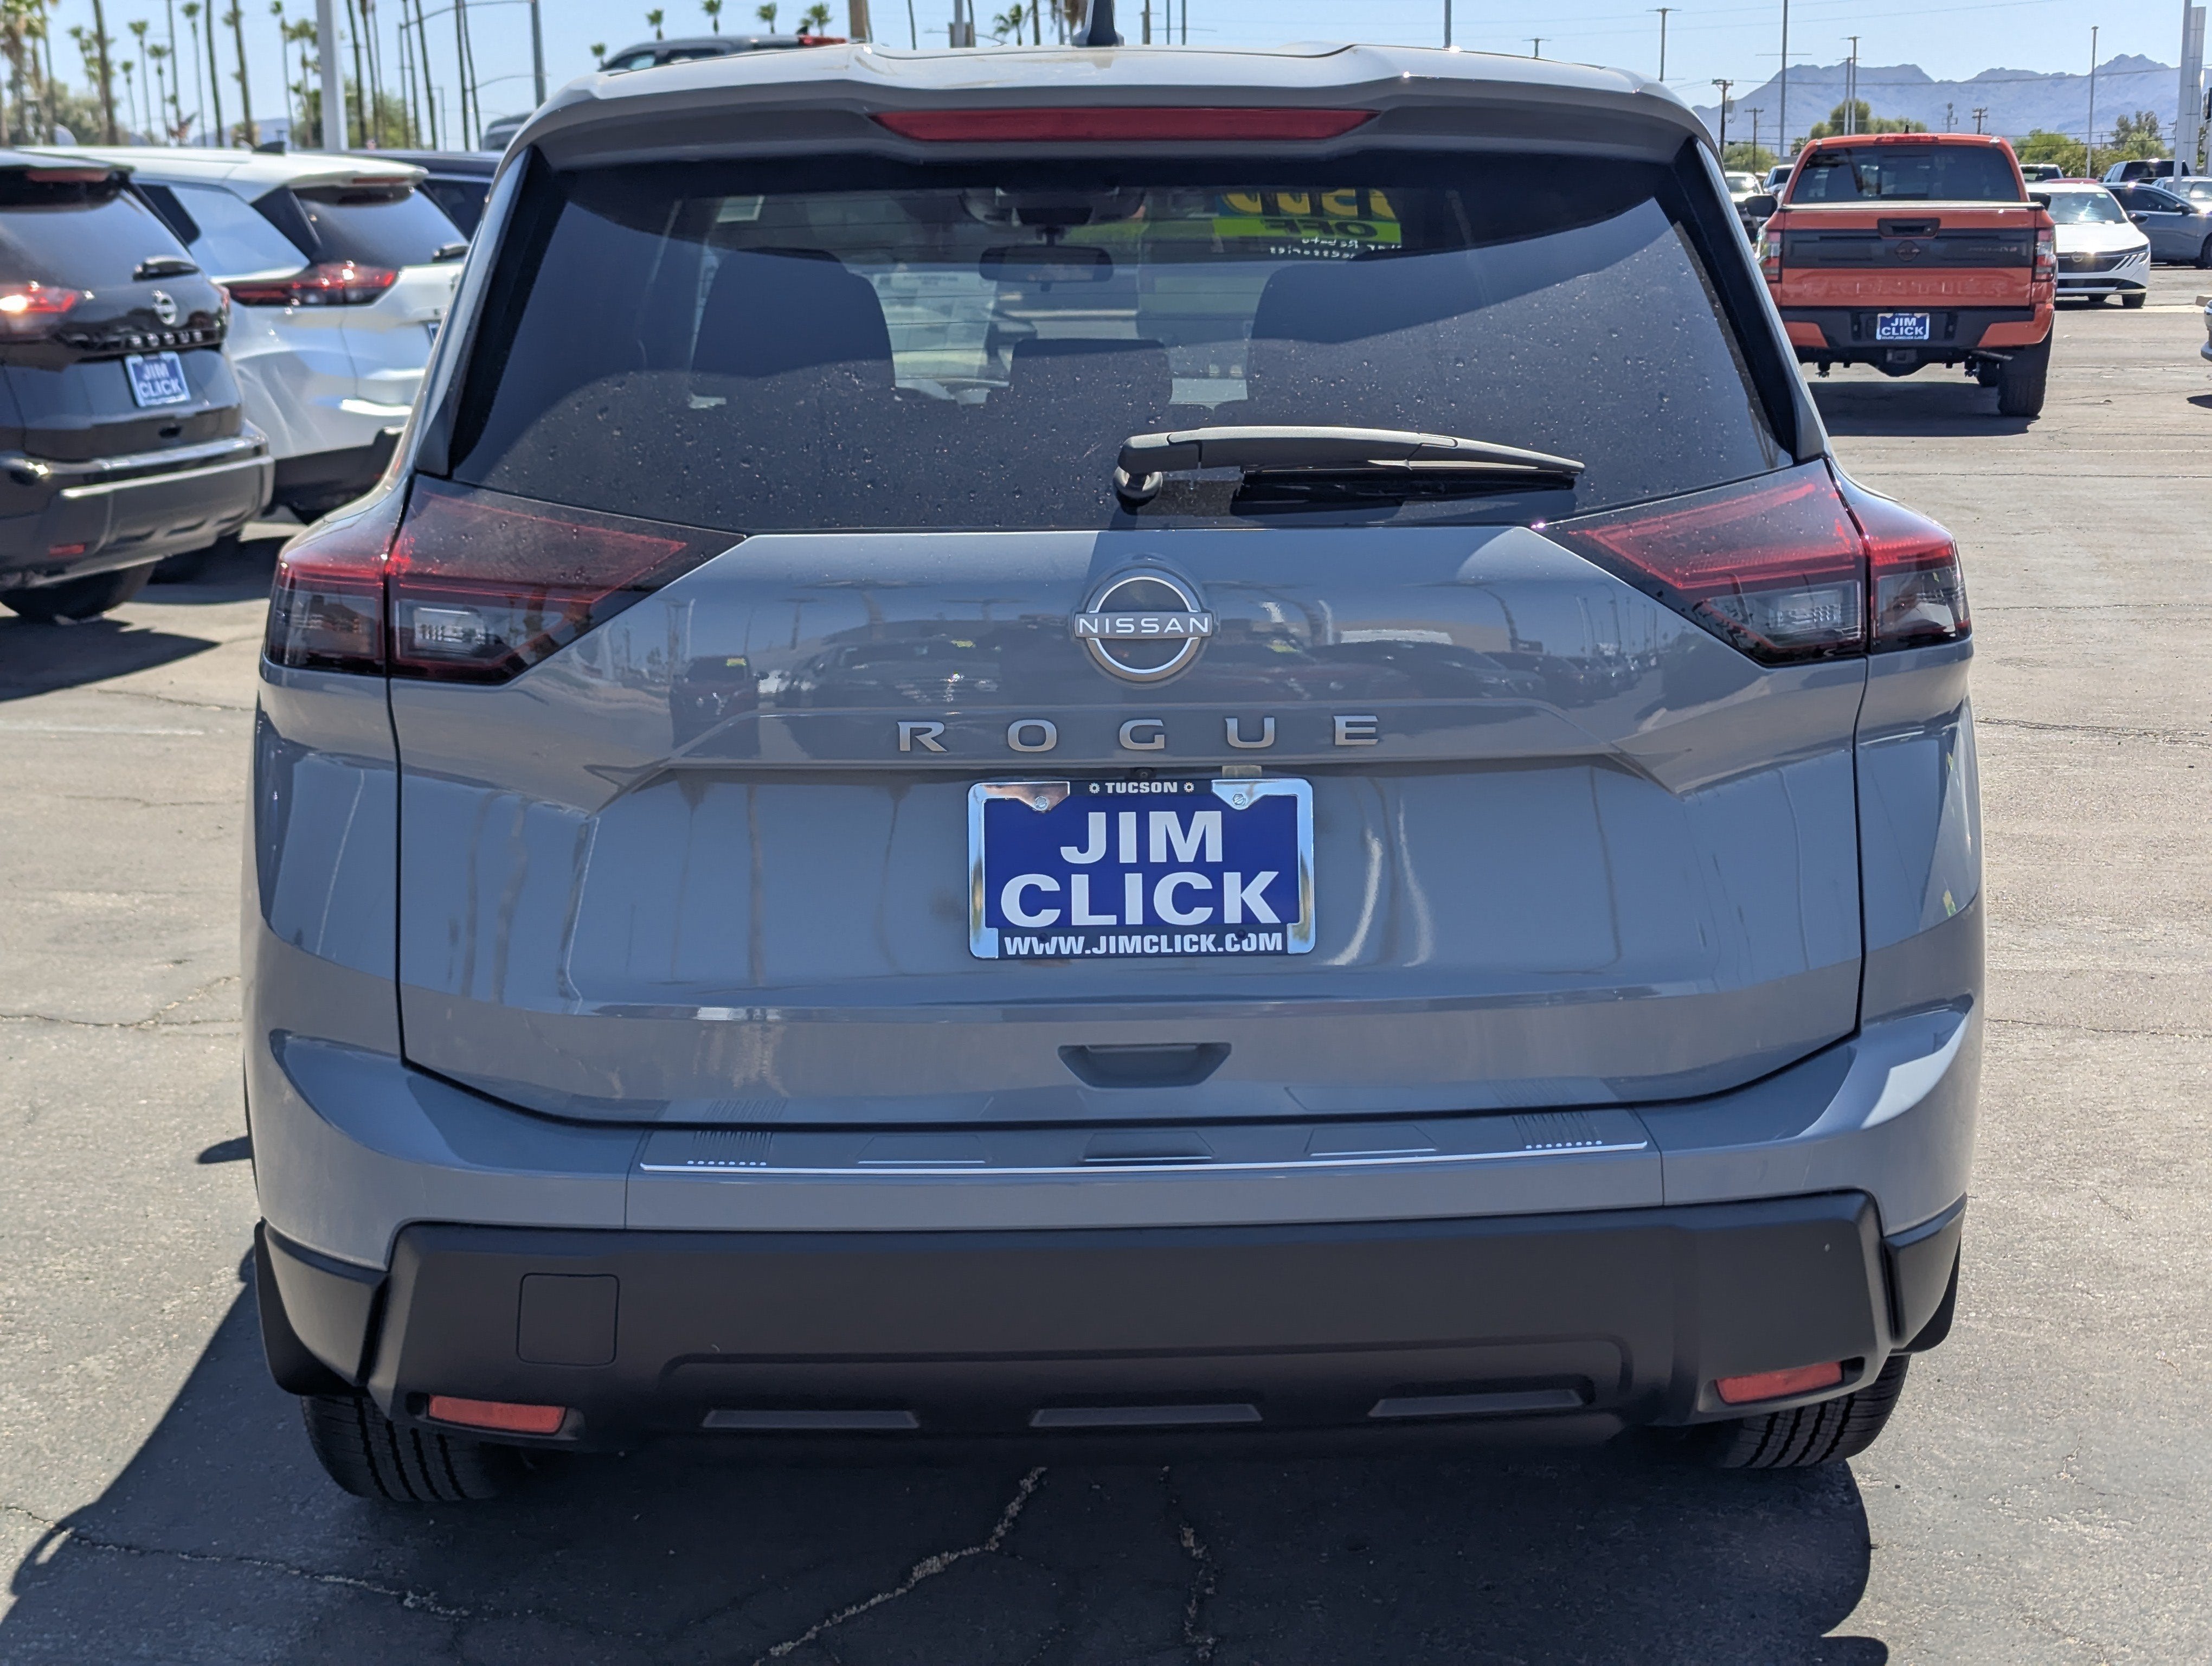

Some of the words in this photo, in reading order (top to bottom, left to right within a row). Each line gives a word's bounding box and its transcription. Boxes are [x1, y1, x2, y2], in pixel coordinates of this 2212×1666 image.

[1881, 326, 1924, 336] CLICK
[1891, 317, 1917, 326] JIM
[143, 362, 170, 380] JIM
[139, 378, 182, 397] CLICK
[1078, 616, 1210, 635] NISSAN
[897, 715, 1379, 753] ROGUE
[1105, 781, 1178, 794] TUCSON
[1060, 810, 1223, 864] JIM
[1000, 871, 1282, 927] CLICK
[1004, 932, 1283, 956] WWW.JIMCLICK.COM
